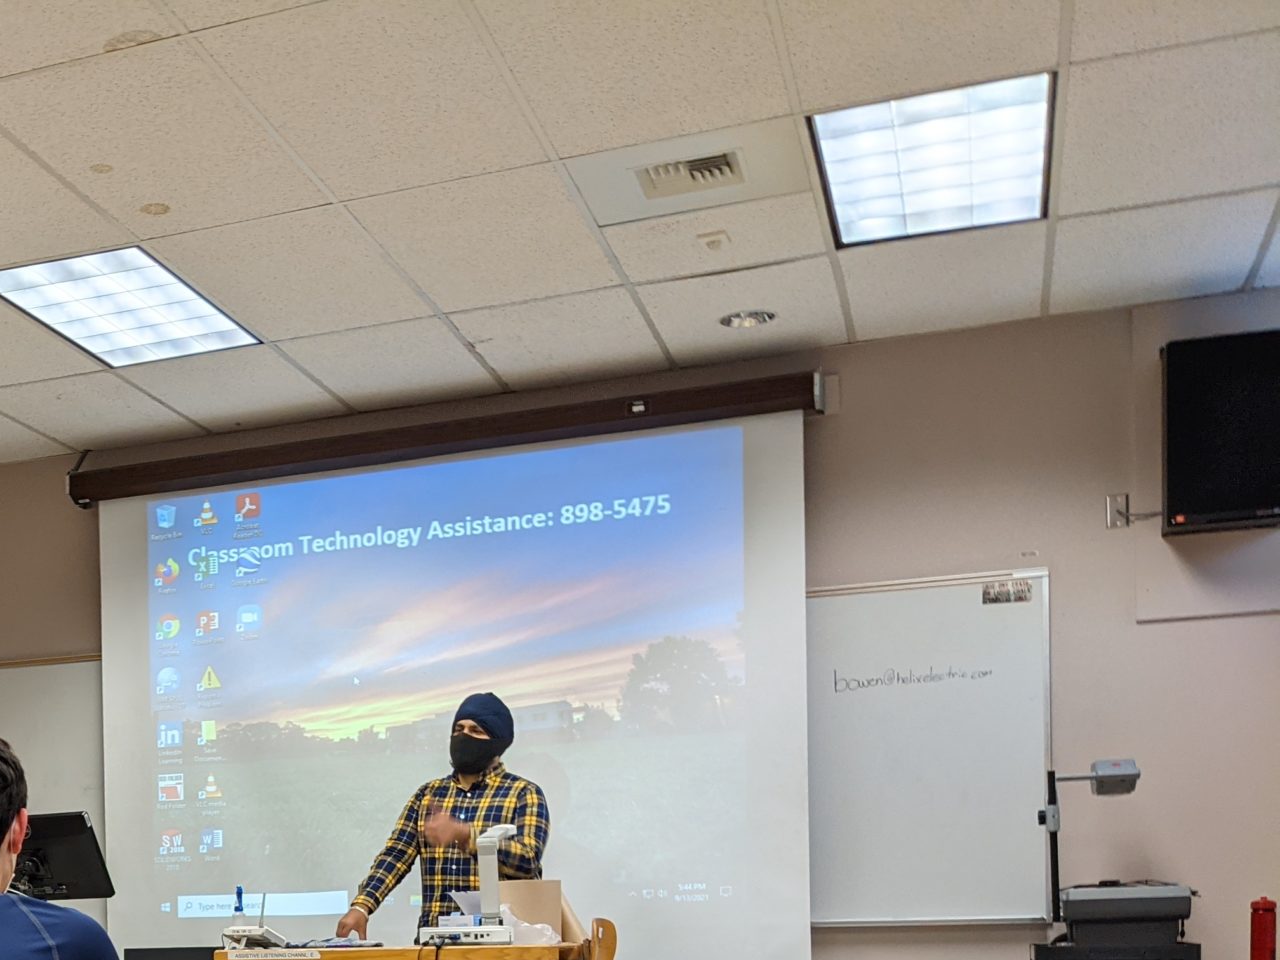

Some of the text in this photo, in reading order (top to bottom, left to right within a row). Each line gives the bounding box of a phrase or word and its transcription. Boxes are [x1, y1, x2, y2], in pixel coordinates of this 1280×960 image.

[299, 525, 422, 554] Technology
[426, 510, 555, 540] Assistance:
[560, 493, 671, 526] 898-5475
[160, 724, 180, 744] in
[199, 902, 215, 912] Type
[216, 902, 231, 910] here
